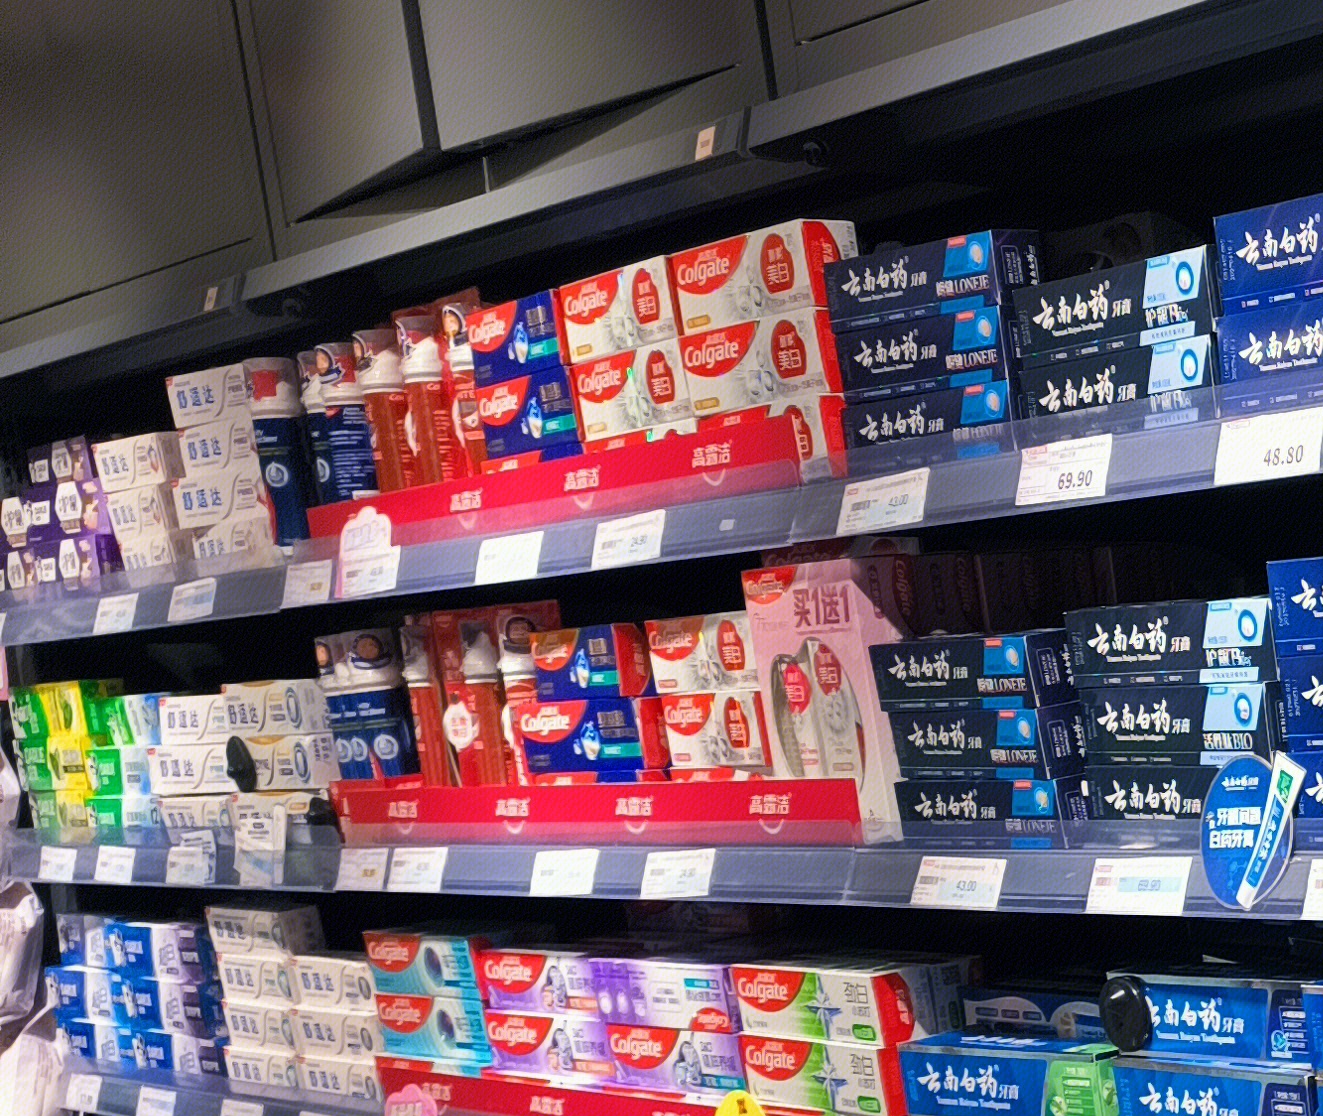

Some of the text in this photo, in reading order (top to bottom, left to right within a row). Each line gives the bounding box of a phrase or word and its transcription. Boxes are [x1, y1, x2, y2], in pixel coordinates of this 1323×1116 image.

[677, 256, 730, 284] Colgate
[564, 288, 608, 319] Colgate
[684, 342, 739, 367] Colgate
[576, 365, 621, 394] Colgate
[1263, 445, 1304, 467] 48.80
[1058, 471, 1092, 489] 69.90
[520, 713, 570, 736] Colgate
[737, 980, 788, 1000] Colgate
[610, 1034, 662, 1058] Colgate
[746, 1049, 796, 1069] Colgate
